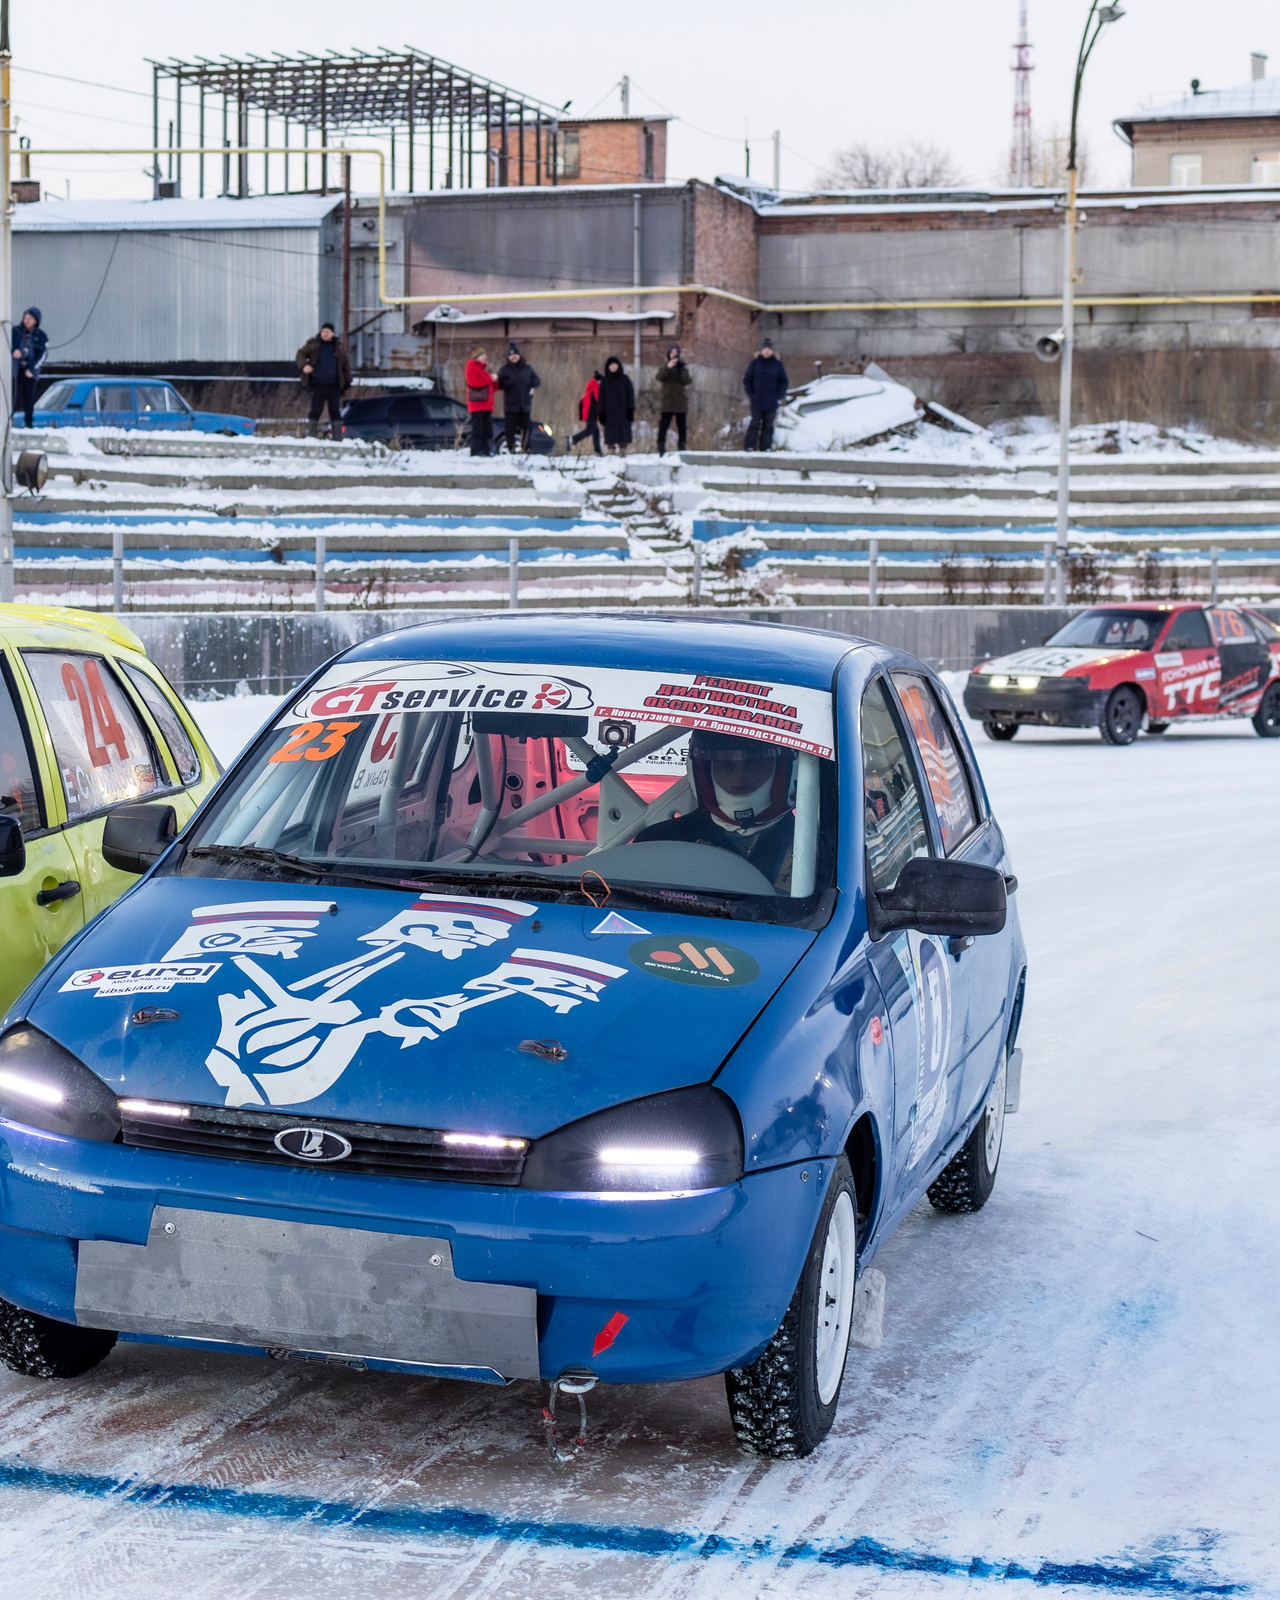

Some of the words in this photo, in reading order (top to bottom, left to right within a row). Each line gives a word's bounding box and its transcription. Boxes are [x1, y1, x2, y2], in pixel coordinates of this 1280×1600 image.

[1212, 609, 1245, 637] 76
[694, 675, 773, 697] РЕМОНТ
[656, 683, 797, 718] ДИАГНОСТИКА
[61, 660, 129, 767] 24
[611, 709, 683, 724] Новокузнецк
[643, 697, 803, 734] ОБСЛУЖИВАНИЕ
[267, 721, 362, 763] 23
[107, 965, 216, 980] eurol
[644, 961, 681, 971] ВКУСНО
[699, 971, 730, 982] ТОЧКА
[98, 985, 171, 994] sibsklad.ru
